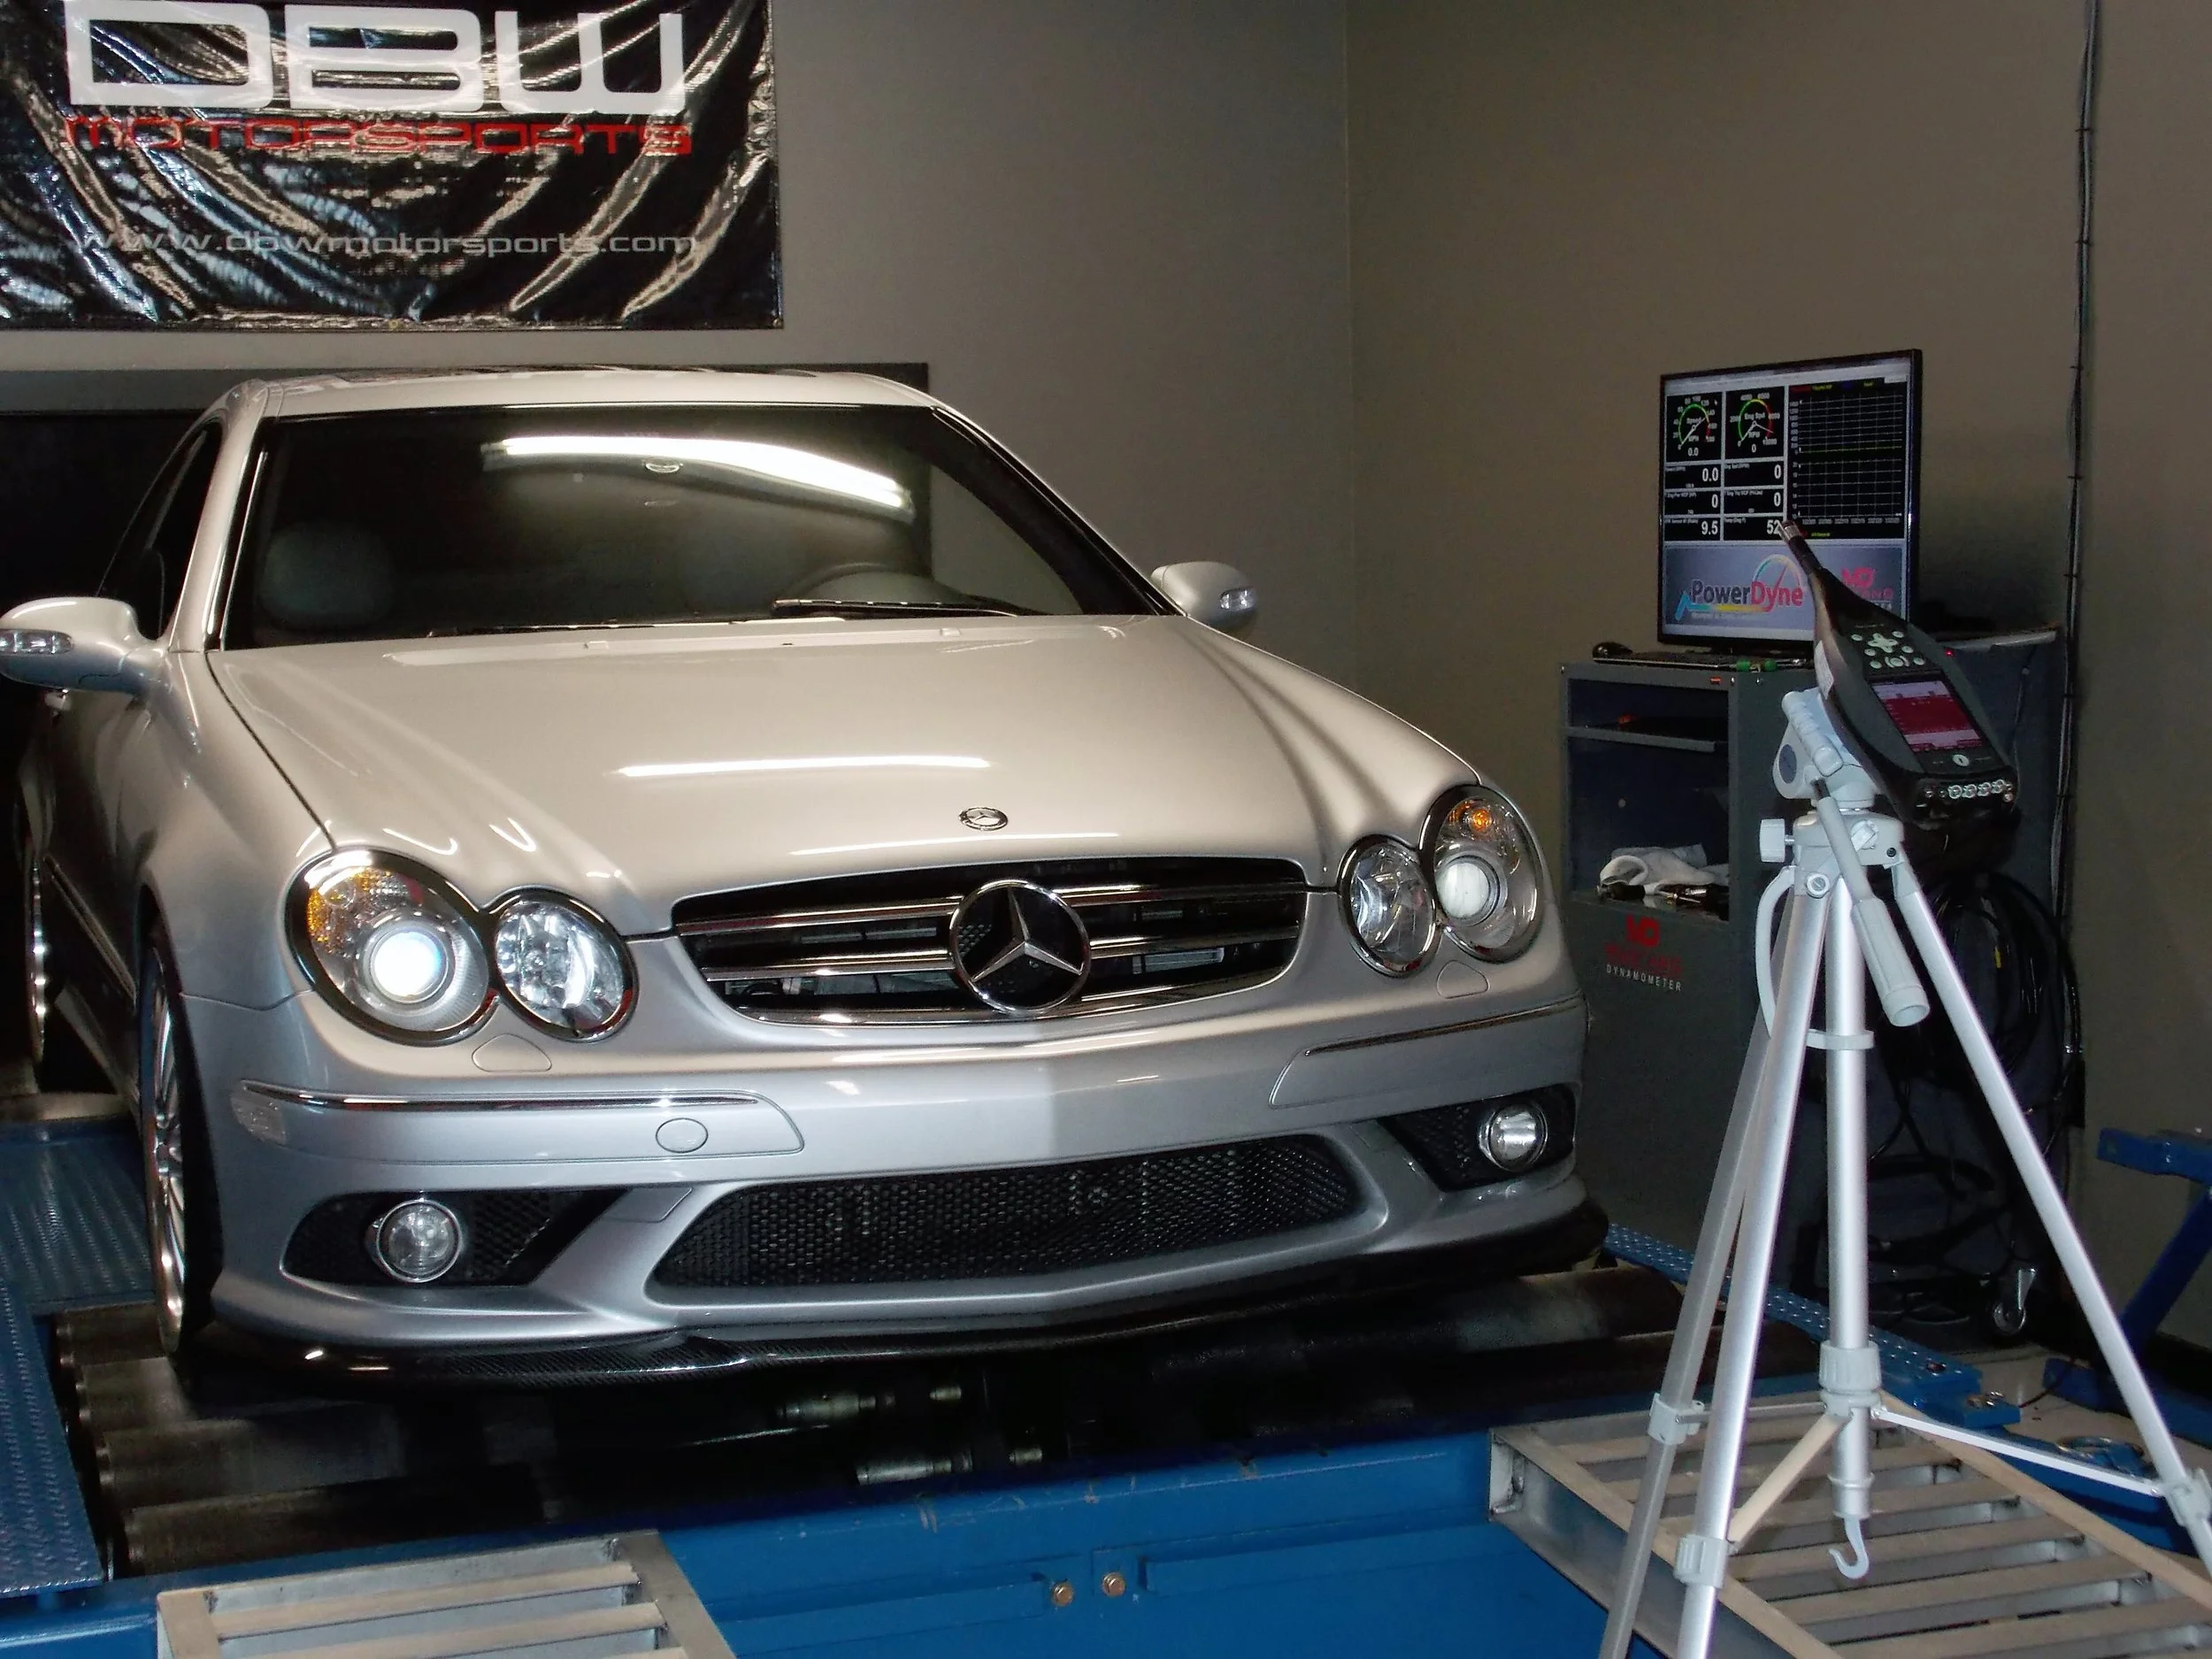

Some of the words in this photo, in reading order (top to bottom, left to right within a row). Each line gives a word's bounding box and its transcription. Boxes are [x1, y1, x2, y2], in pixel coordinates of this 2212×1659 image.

[65, 0, 686, 114] DBW
[65, 115, 692, 156] MOTORSPORTS
[84, 230, 696, 257] www.dbwmotorsports.com
[1701, 466, 1718, 482] 0.0
[1774, 465, 1781, 480] 0
[1711, 494, 1718, 509] 0
[1774, 492, 1781, 507] 0
[1701, 520, 1718, 535] 9.5
[1691, 580, 1804, 612] PowerDyne
[1606, 964, 1681, 992] DYNAMOMETER
